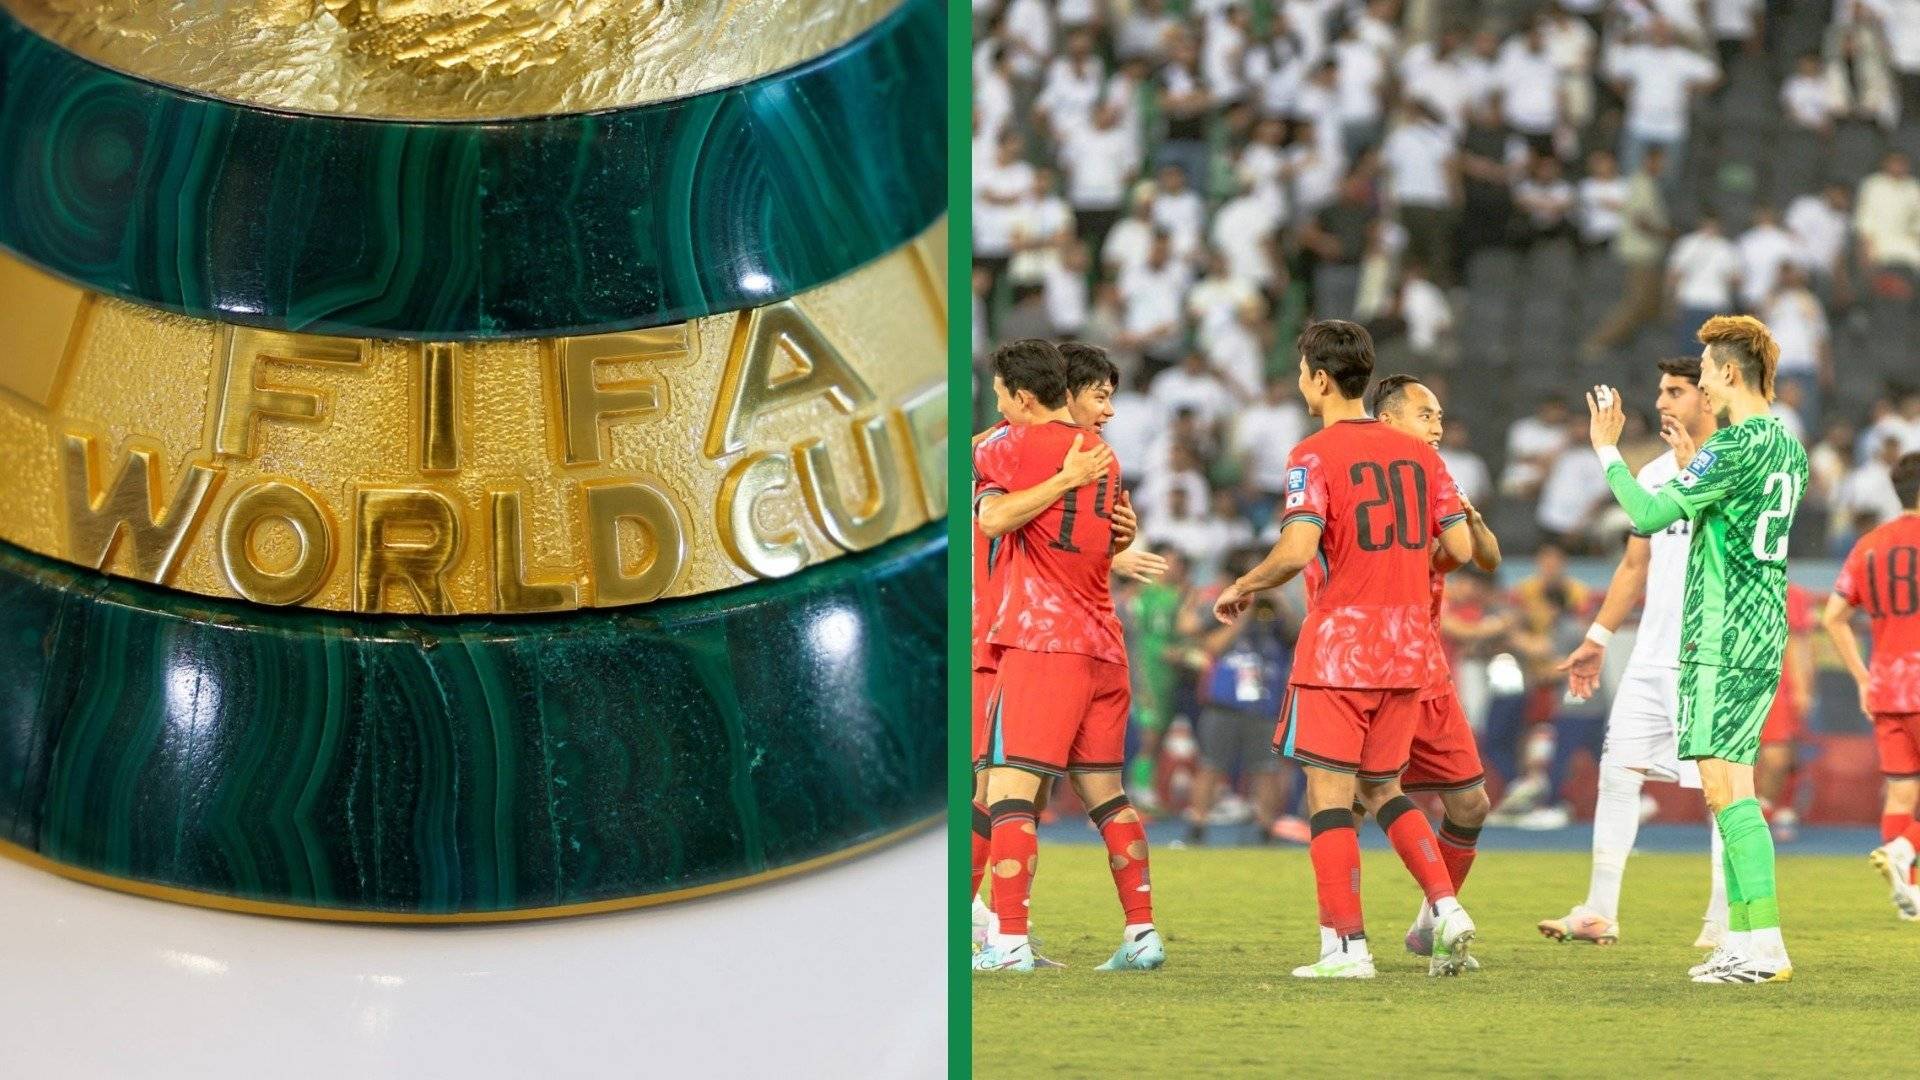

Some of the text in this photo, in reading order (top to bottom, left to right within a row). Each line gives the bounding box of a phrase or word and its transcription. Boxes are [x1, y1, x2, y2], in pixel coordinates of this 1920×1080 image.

[214, 299, 877, 470] FIFA
[63, 432, 686, 615] WORLD
[1350, 459, 1427, 552] 20
[1867, 546, 1918, 617] 18
